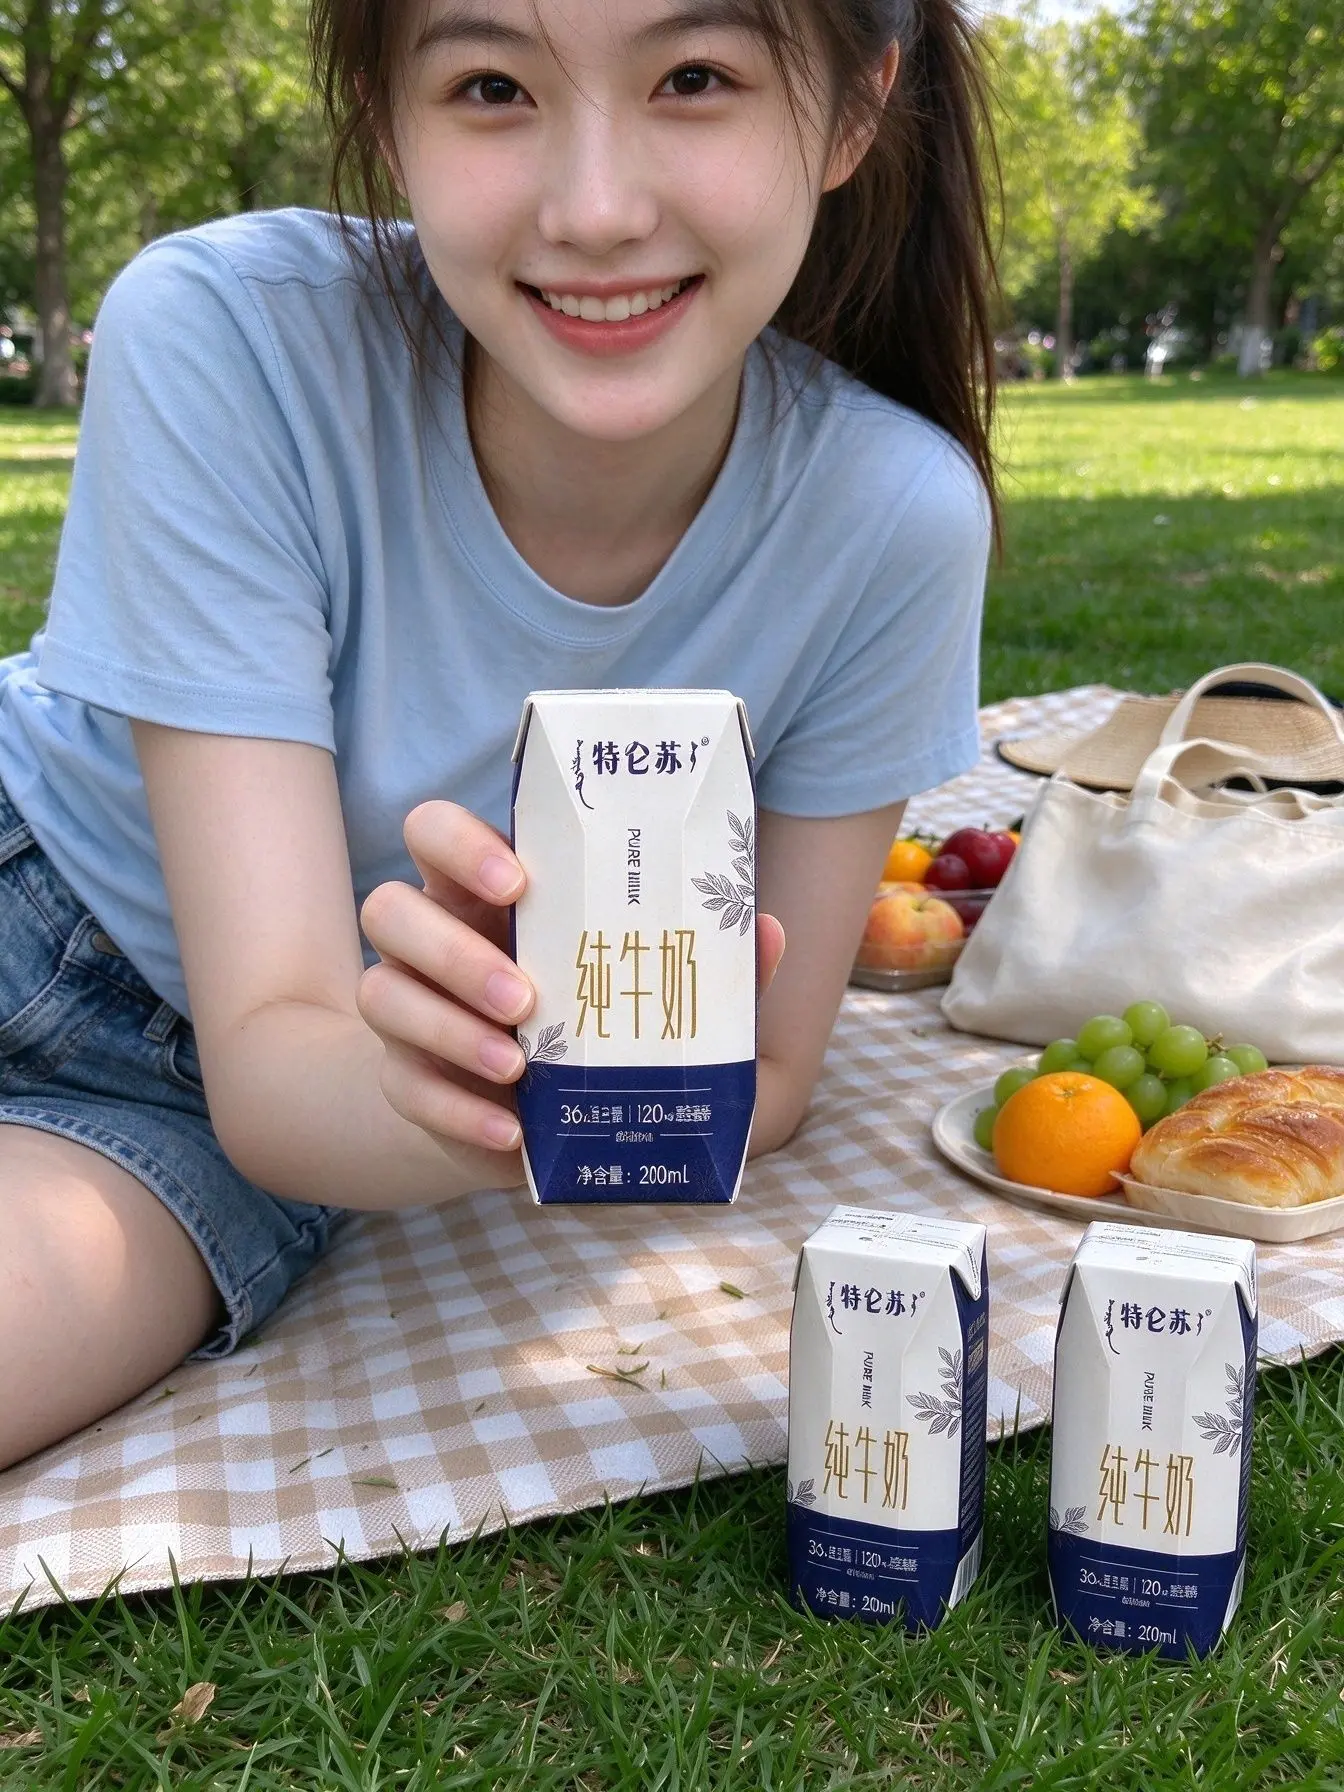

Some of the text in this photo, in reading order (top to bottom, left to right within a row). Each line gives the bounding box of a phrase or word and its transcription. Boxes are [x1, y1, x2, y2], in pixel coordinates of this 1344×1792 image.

[592, 740, 683, 776] 特仑苏
[627, 828, 641, 868] PURE
[575, 929, 696, 1039] 纯牛奶
[840, 1284, 905, 1317] 特仑苏
[1120, 1302, 1192, 1335] 特仑苏
[823, 1420, 909, 1510] 纯牛奶
[1097, 1444, 1194, 1537] 纯牛奶
